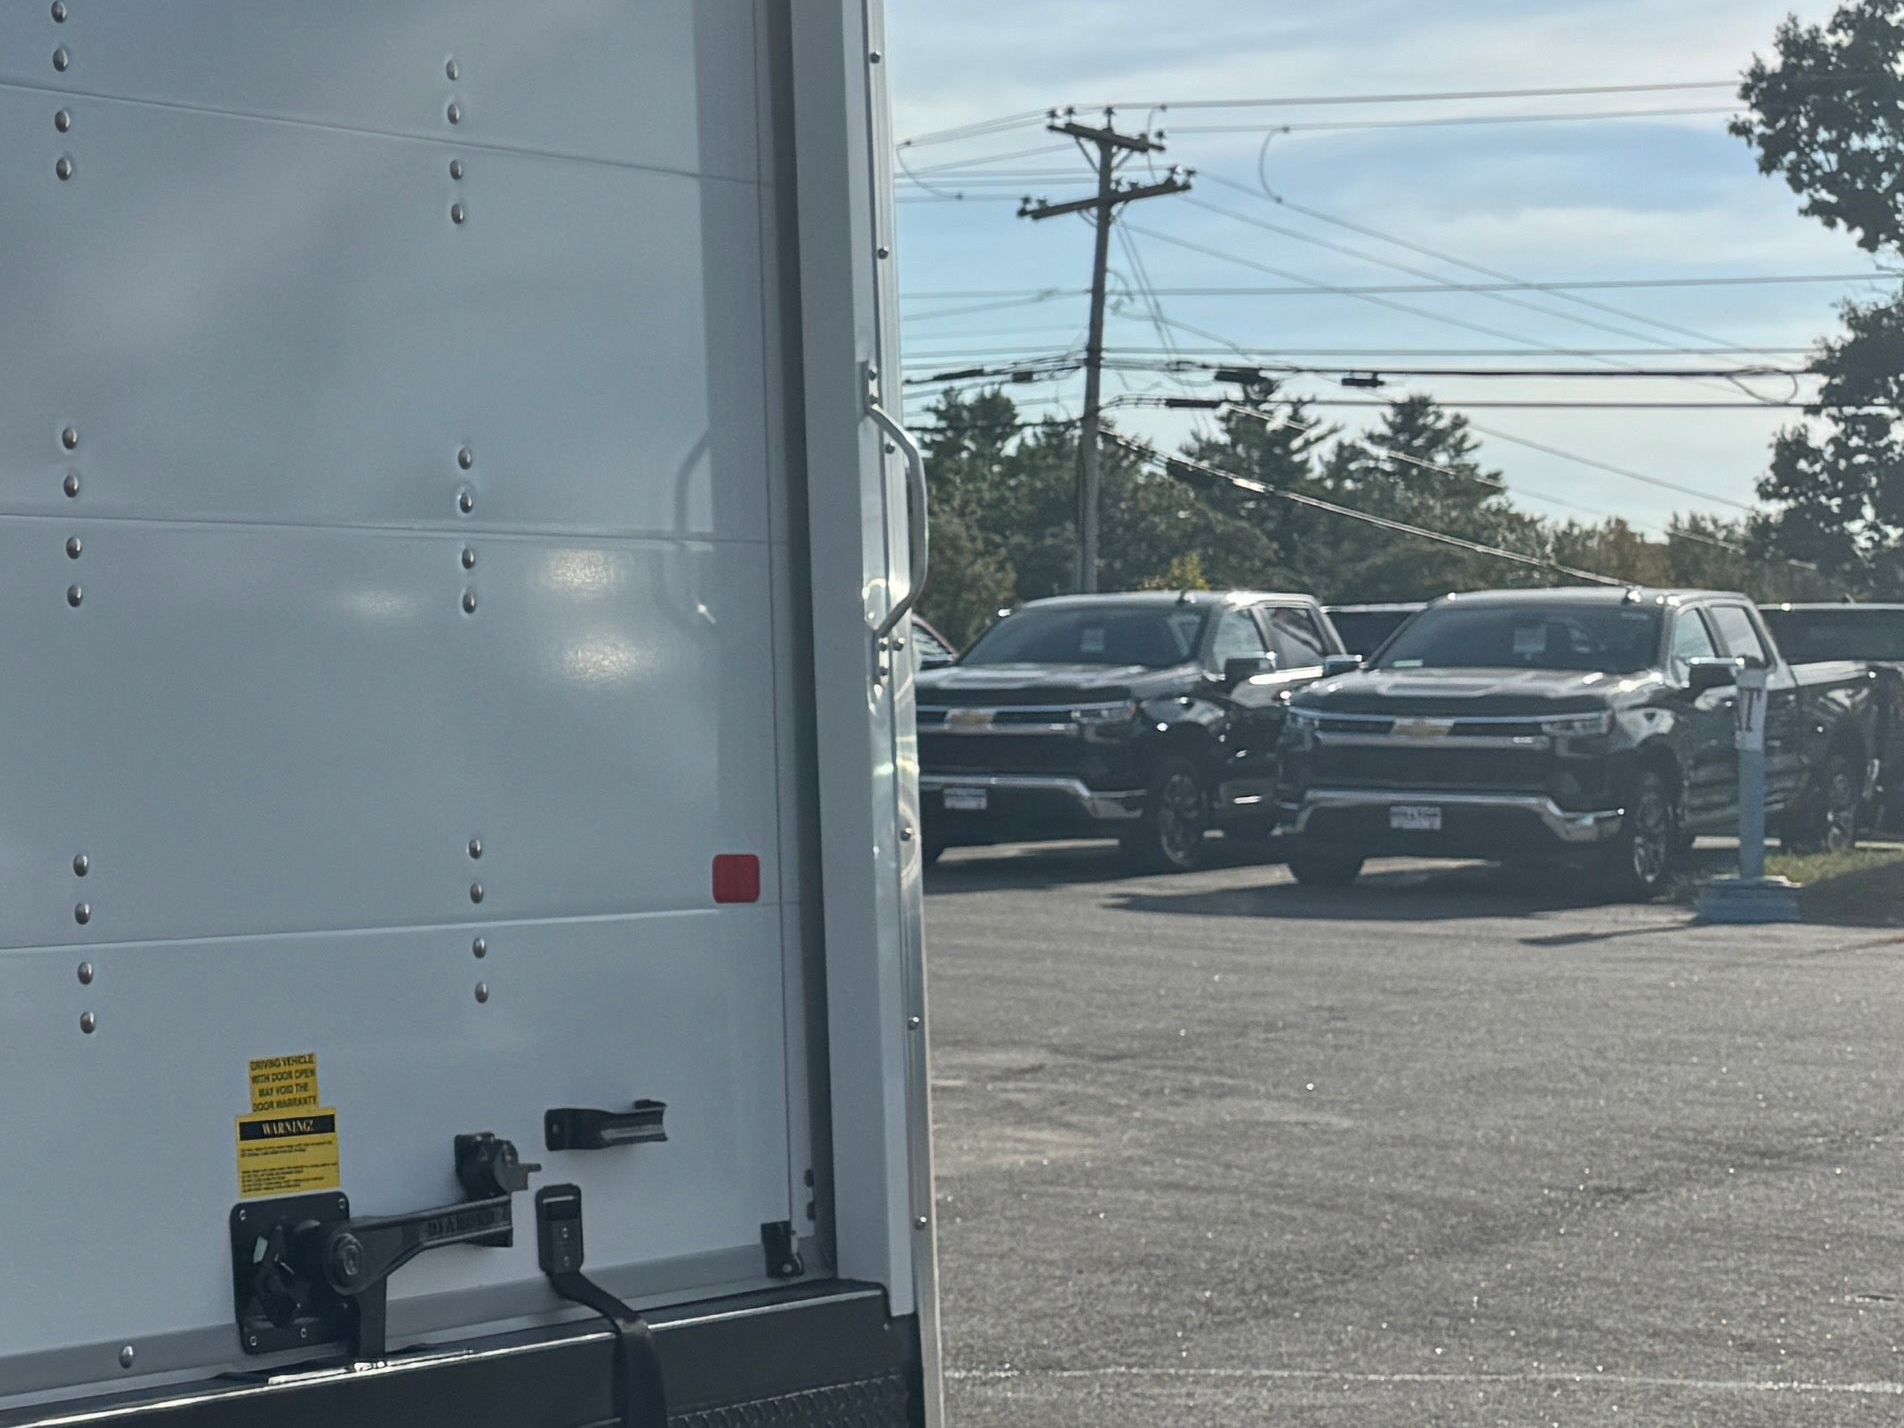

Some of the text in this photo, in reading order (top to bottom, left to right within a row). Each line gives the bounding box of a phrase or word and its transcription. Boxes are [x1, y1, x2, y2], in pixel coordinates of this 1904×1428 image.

[272, 1071, 293, 1082] DOOR
[295, 1068, 316, 1079] OPEN
[253, 1100, 274, 1113] DOOR
